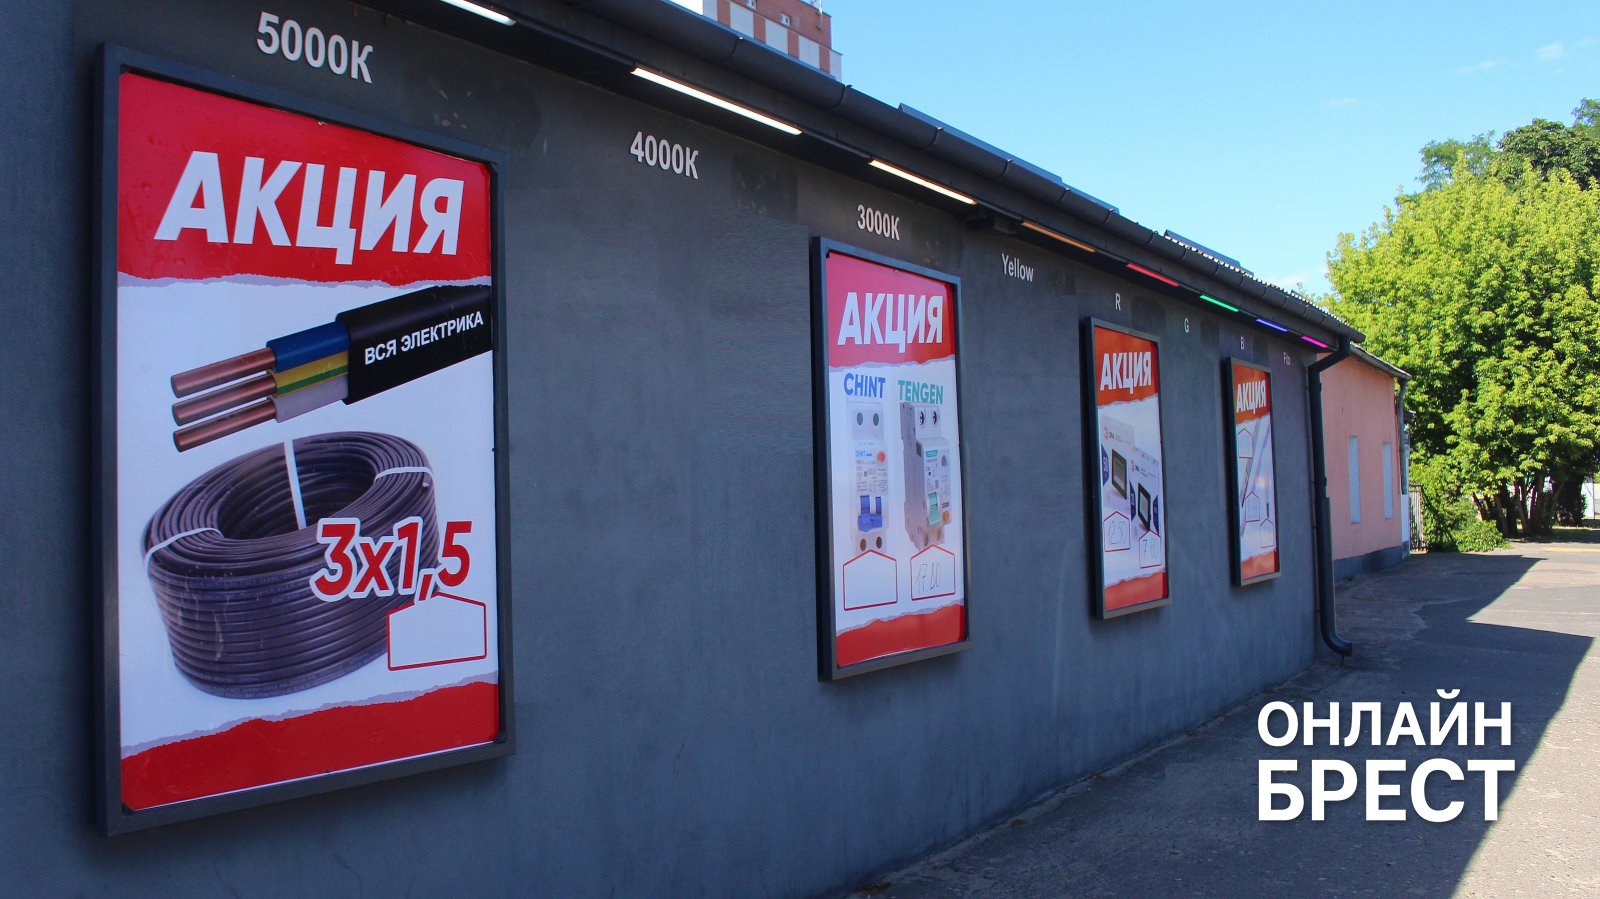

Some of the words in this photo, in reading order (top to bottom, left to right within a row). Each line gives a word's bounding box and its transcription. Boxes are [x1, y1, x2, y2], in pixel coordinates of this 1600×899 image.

[154, 151, 464, 265] АКЦИЯ
[1001, 253, 1034, 282] Yellow
[1115, 293, 1121, 311] R
[837, 291, 944, 353] АКЦИЯ
[1184, 318, 1190, 334] G
[364, 340, 397, 365] ВСЯ
[401, 310, 484, 352] ЭЛЕКТРИКА
[1240, 336, 1245, 350] B
[843, 372, 886, 398] CHINT
[1100, 352, 1152, 394] АКЦИЯ
[898, 380, 944, 405] TENGEN
[1236, 380, 1267, 414] АКЦИЯ
